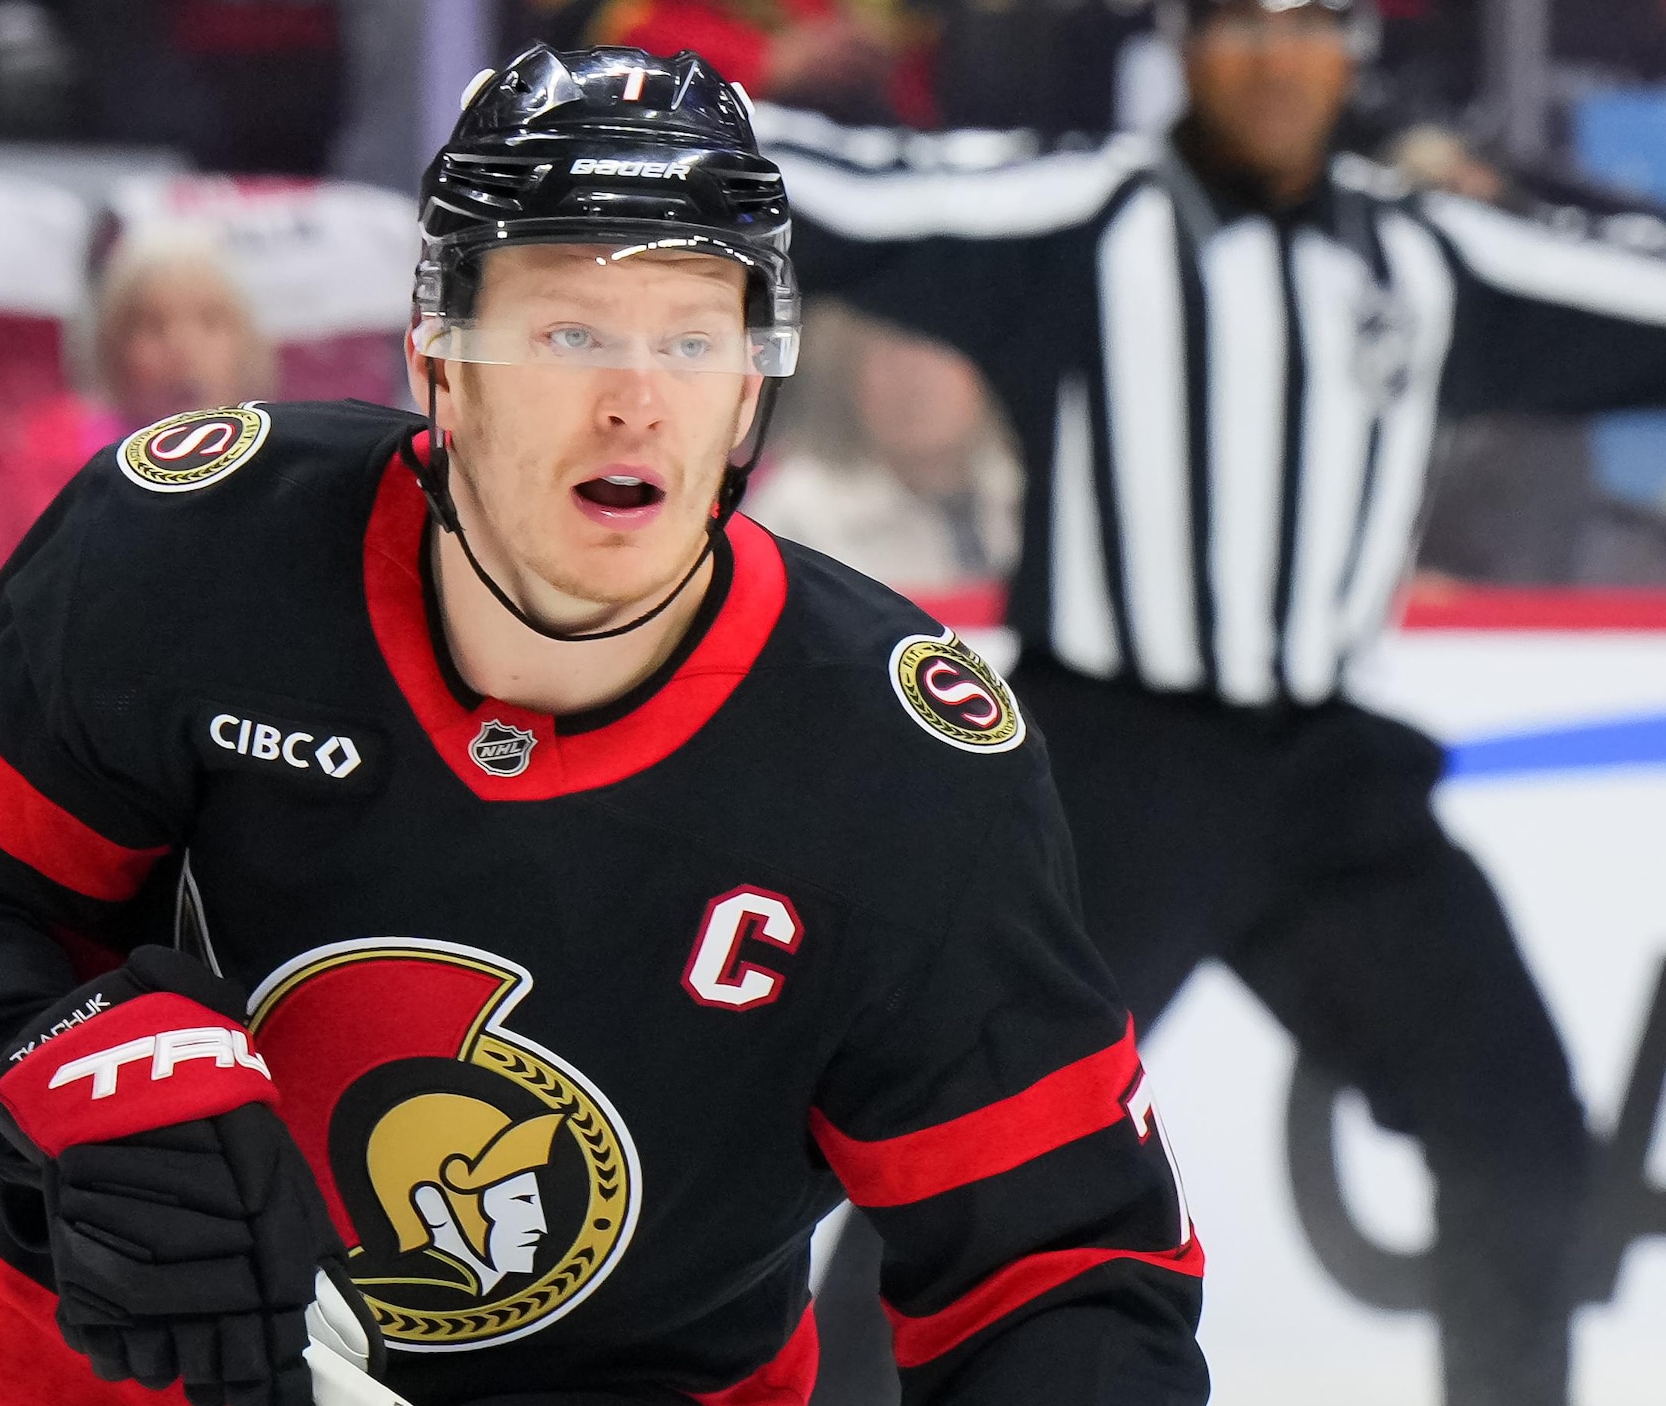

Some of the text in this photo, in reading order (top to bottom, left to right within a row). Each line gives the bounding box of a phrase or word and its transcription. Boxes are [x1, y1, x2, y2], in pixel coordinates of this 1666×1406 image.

[149, 411, 236, 462] S
[922, 658, 1001, 729] S
[209, 713, 314, 769] CIBC
[479, 741, 522, 758] NHL
[680, 883, 806, 1012] C
